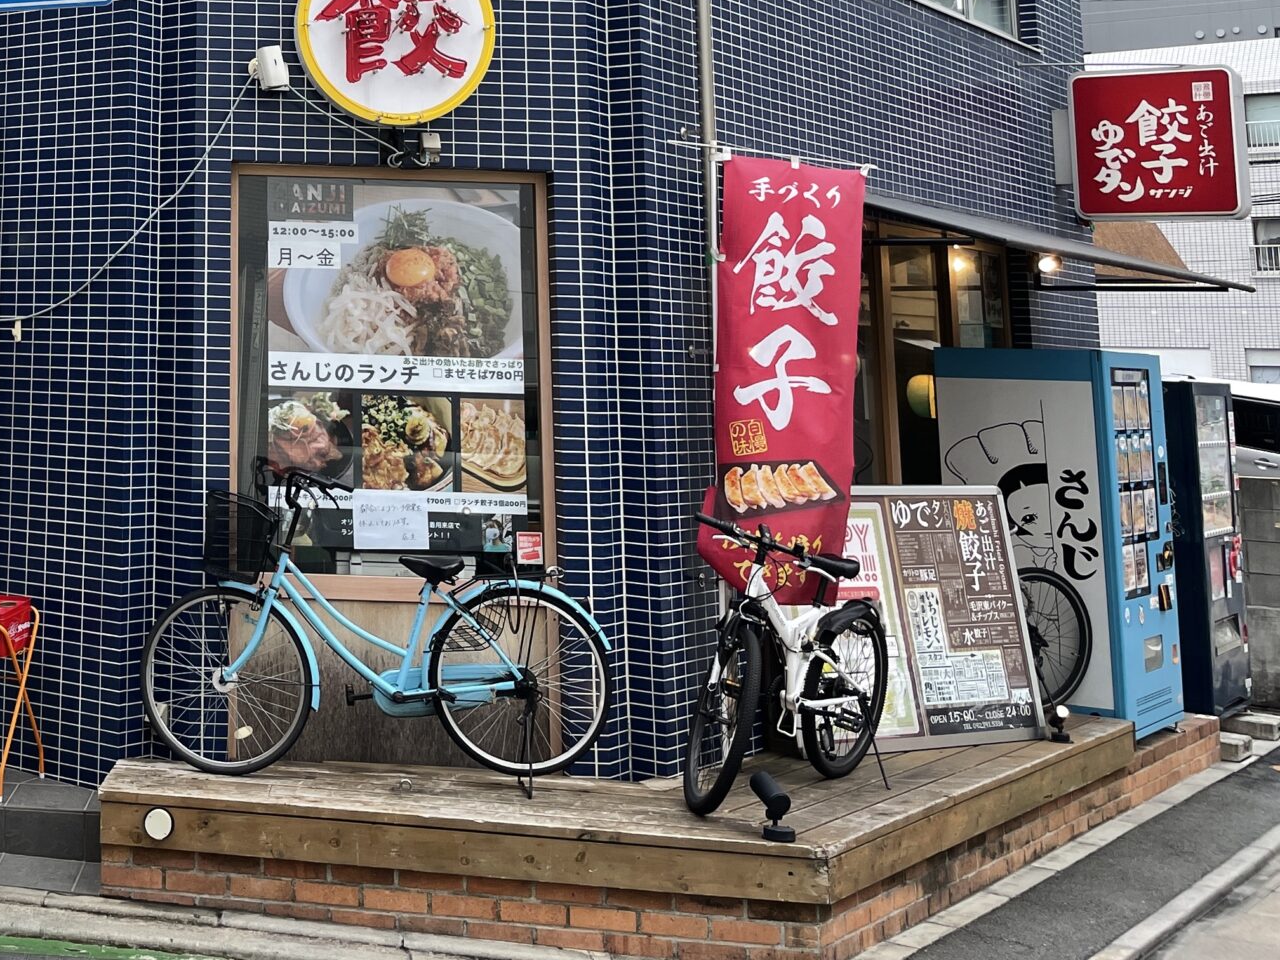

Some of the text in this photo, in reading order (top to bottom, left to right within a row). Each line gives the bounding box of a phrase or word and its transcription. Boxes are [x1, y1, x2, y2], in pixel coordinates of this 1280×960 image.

[1124, 97, 1192, 184] 餃子
[1195, 103, 1220, 178] あご出汁
[1091, 119, 1145, 202] ゆでタン
[748, 176, 842, 209] 手づくり
[1149, 185, 1194, 200] サンジ
[277, 247, 335, 267] 月〜金
[733, 212, 839, 432] 餃子
[270, 360, 420, 385] さんじのランチ
[444, 368, 524, 382] まぜそば780円
[891, 499, 943, 528] ゆでタン
[1055, 469, 1099, 581] さんじ
[975, 500, 997, 570] あご出汁
[930, 714, 948, 724] OPEN
[985, 709, 1005, 720] CLOSE
